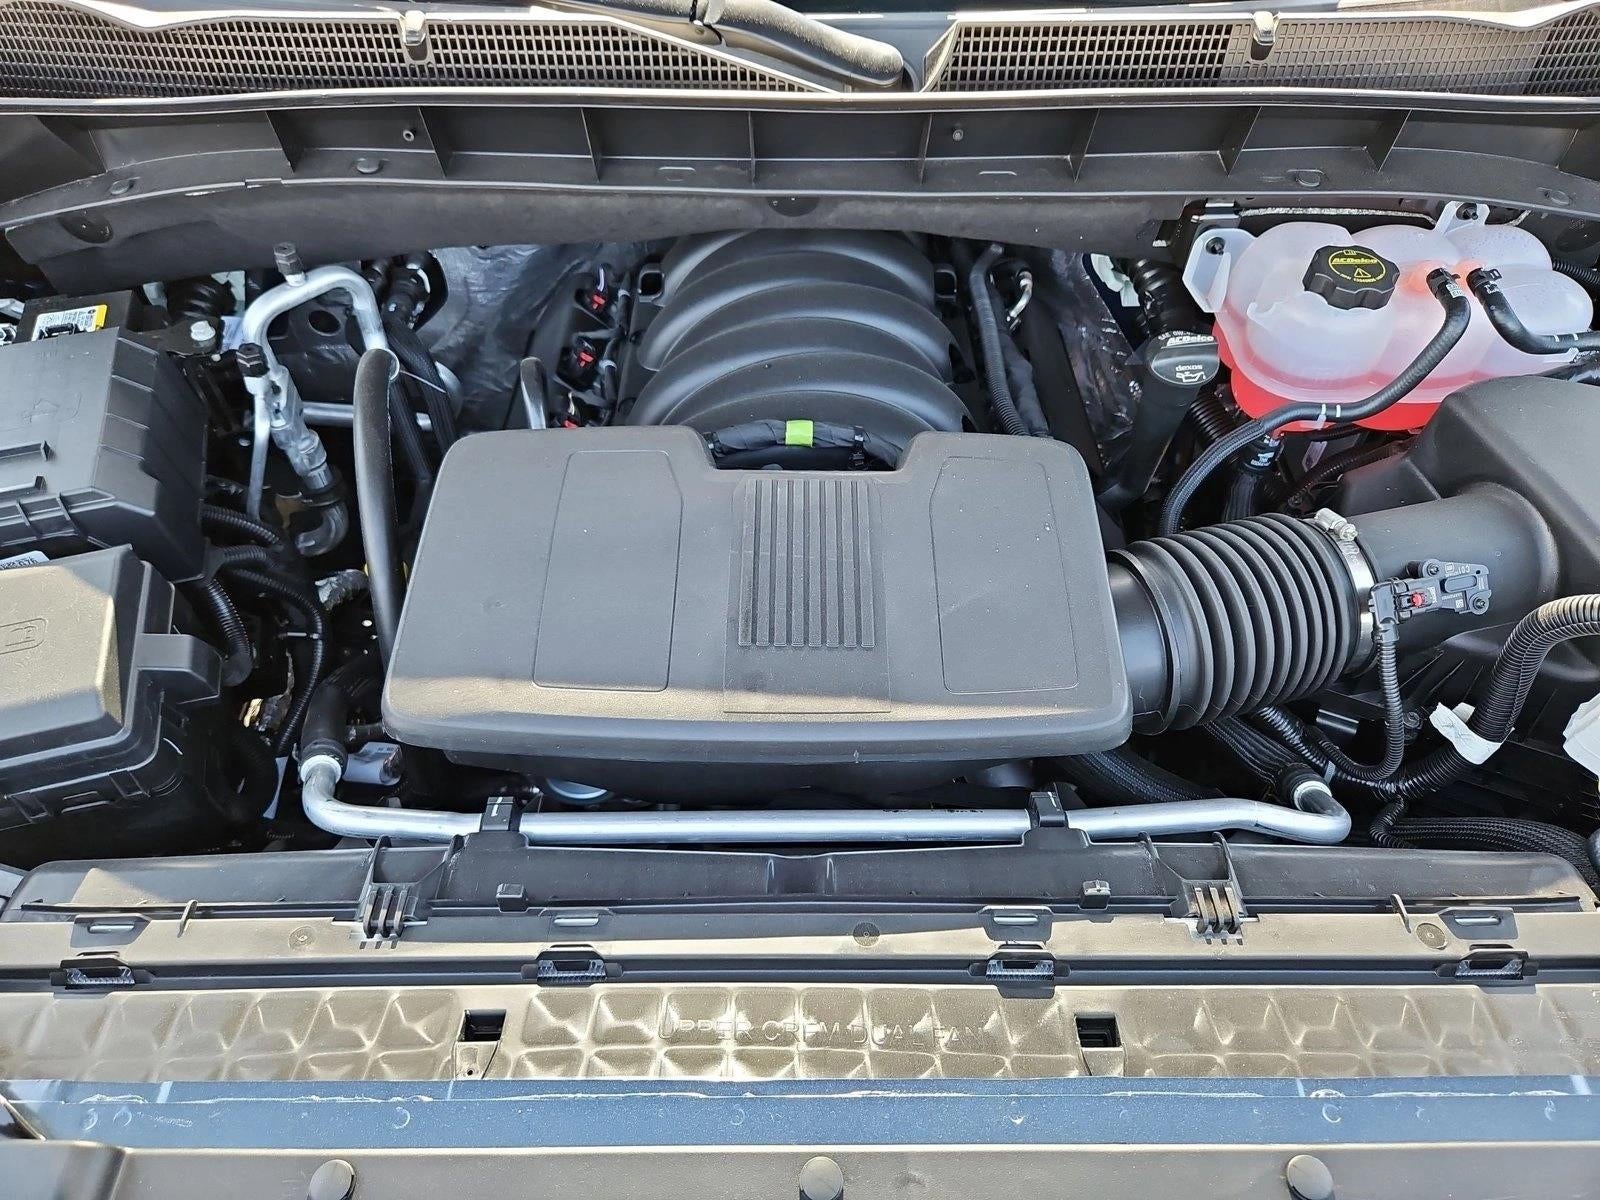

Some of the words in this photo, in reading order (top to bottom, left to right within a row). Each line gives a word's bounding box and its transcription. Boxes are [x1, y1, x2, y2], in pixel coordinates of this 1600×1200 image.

[1331, 257, 1378, 265] ACDelco
[1166, 335, 1215, 347] ACDelco
[658, 1019, 752, 1040] UPPER
